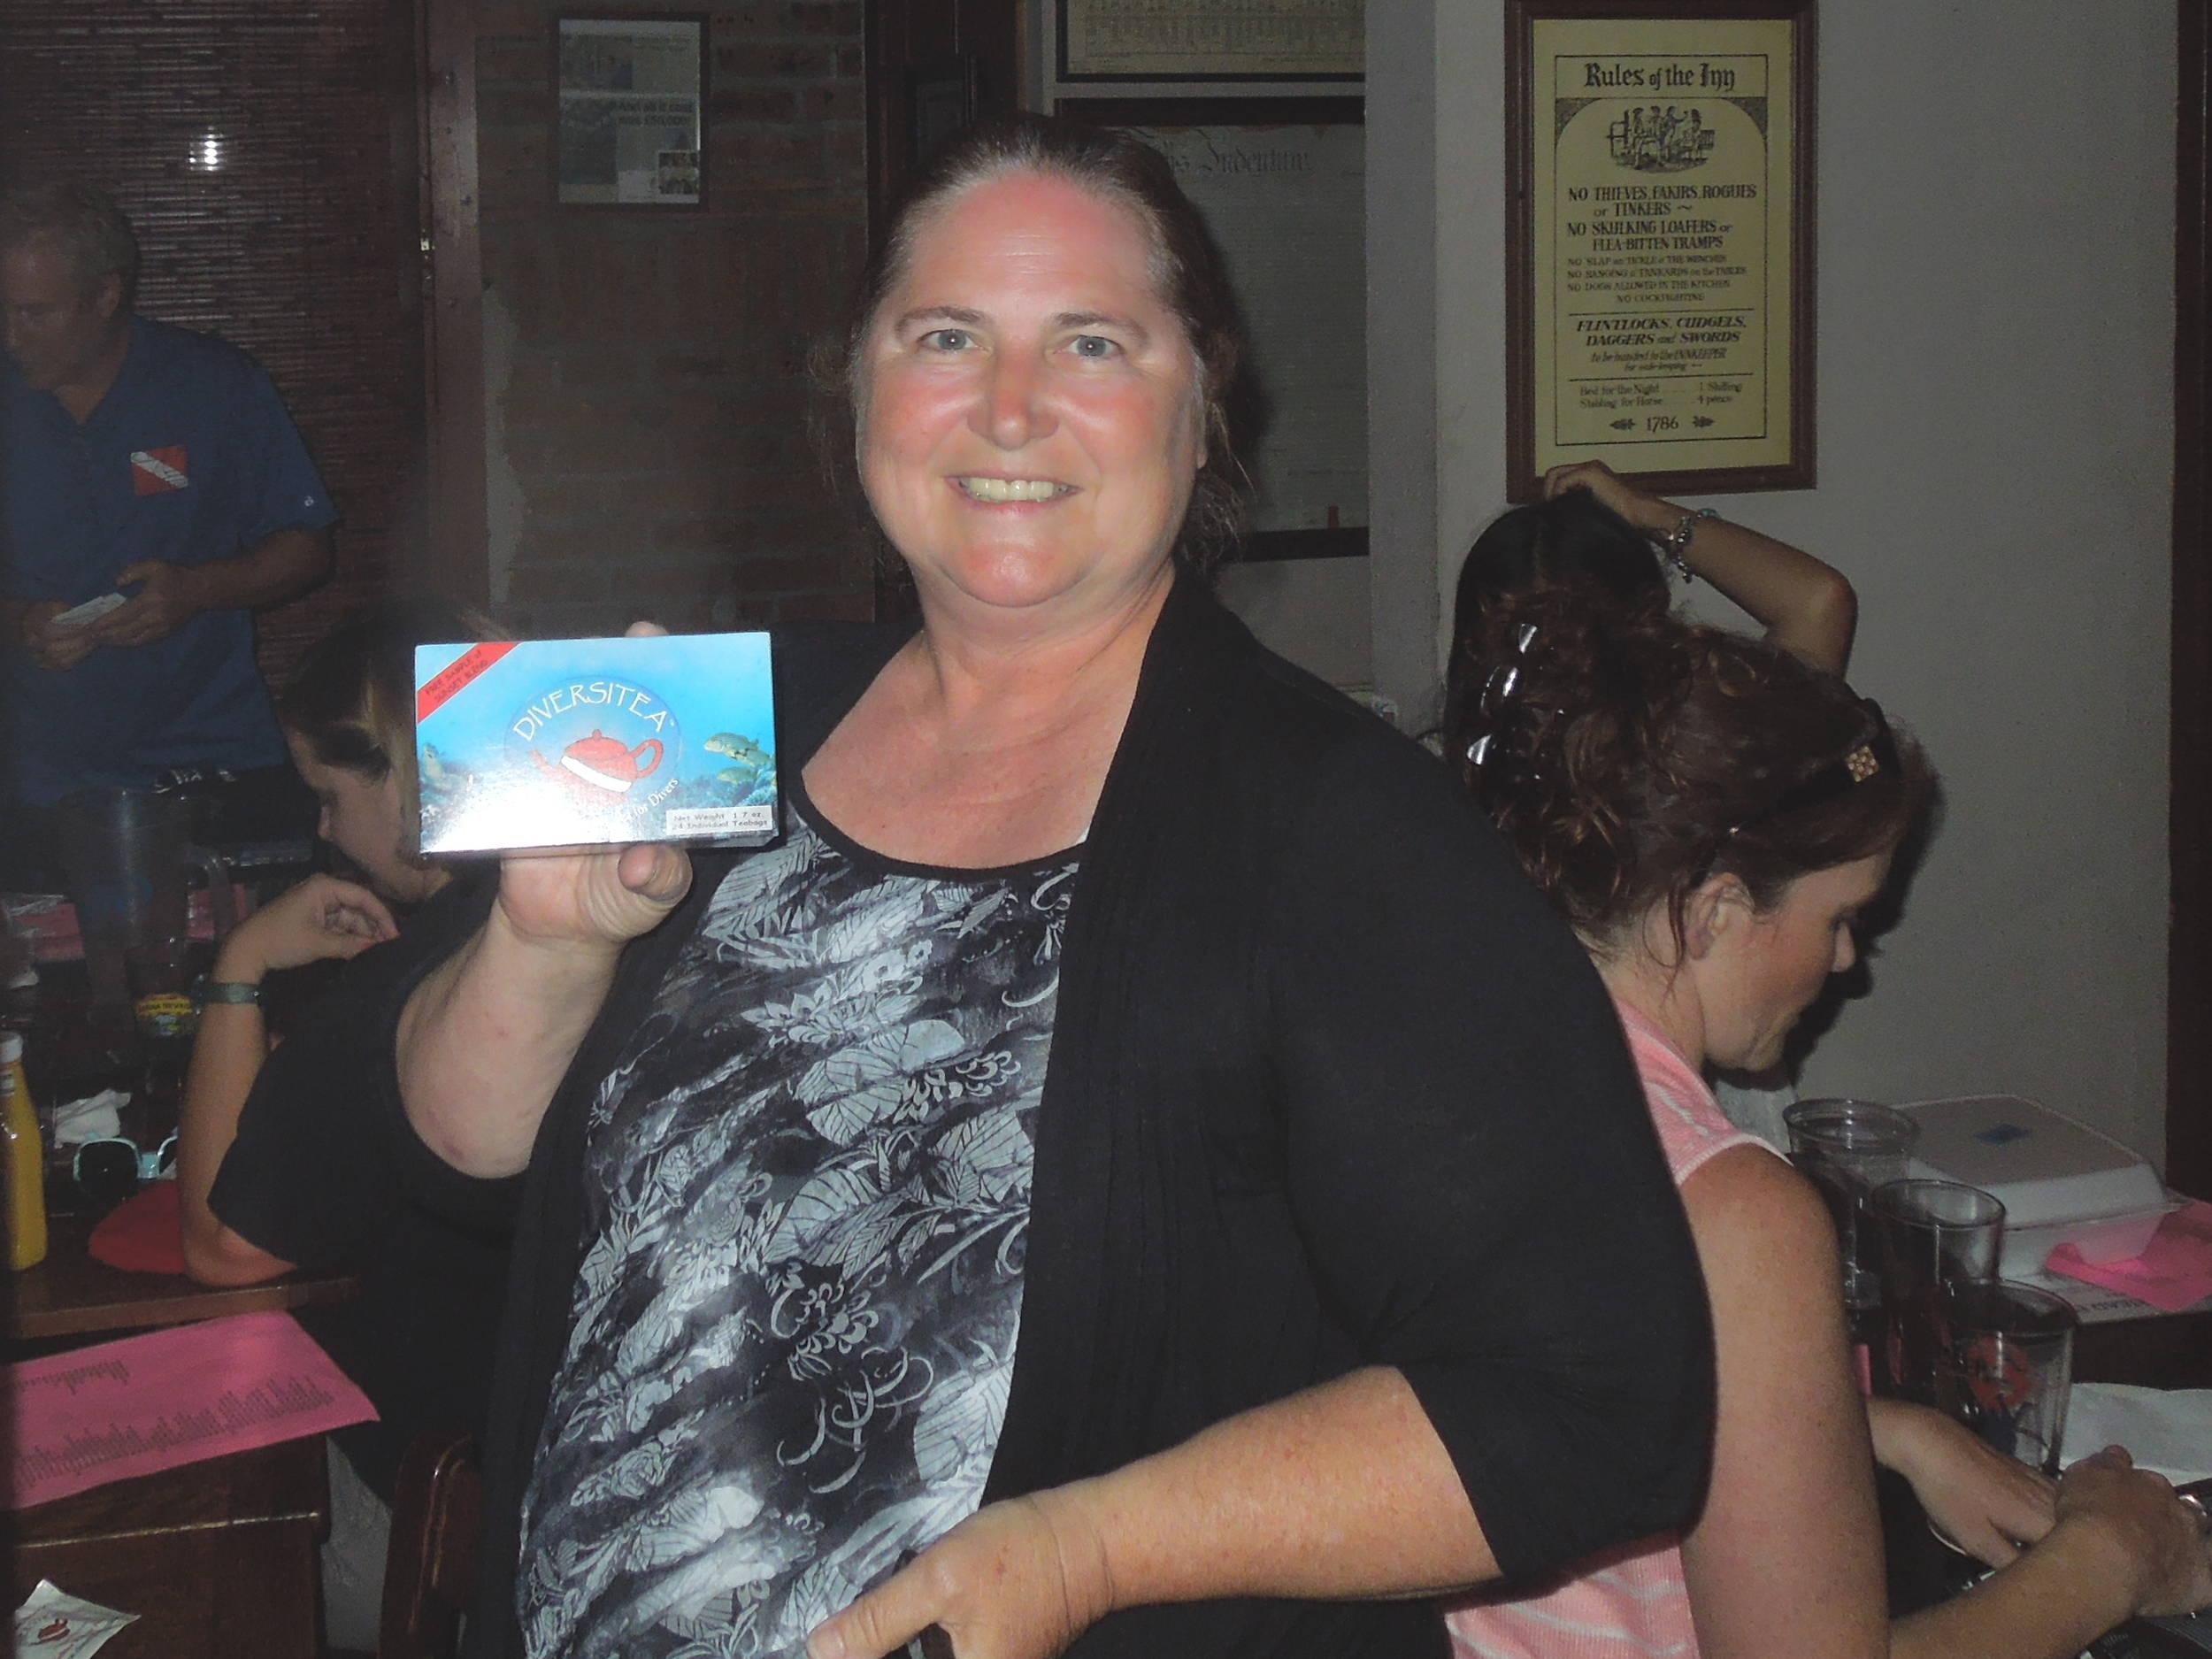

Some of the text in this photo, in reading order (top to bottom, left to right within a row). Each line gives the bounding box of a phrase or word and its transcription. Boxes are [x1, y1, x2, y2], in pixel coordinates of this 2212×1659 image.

[1584, 62, 1643, 87] Rules
[1648, 68, 1662, 90] of
[1666, 64, 1694, 87] the
[1568, 187, 1588, 201] NO
[1702, 184, 1756, 199] ROGUES
[1594, 202, 1671, 217] or TINKERS
[1567, 219, 1733, 236] NO SKULKING LOAFERS or
[1593, 236, 1724, 251] FLEA-BITTEN TRAMPS
[1568, 257, 1582, 266] NO
[1586, 257, 1610, 266] SLAP
[1567, 270, 1582, 279] NO
[1567, 282, 1581, 292] NO
[1614, 280, 1656, 290] ALLOWED
[1671, 280, 1690, 289] THE
[1691, 279, 1730, 288] KITCHEN
[1617, 295, 1632, 303] NO
[1586, 334, 1655, 347] DAGGERS
[1679, 332, 1740, 344] SWORDS
[1647, 416, 1679, 434] 1786
[512, 680, 669, 741] DIVERSITEA
[648, 778, 680, 808] Divers
